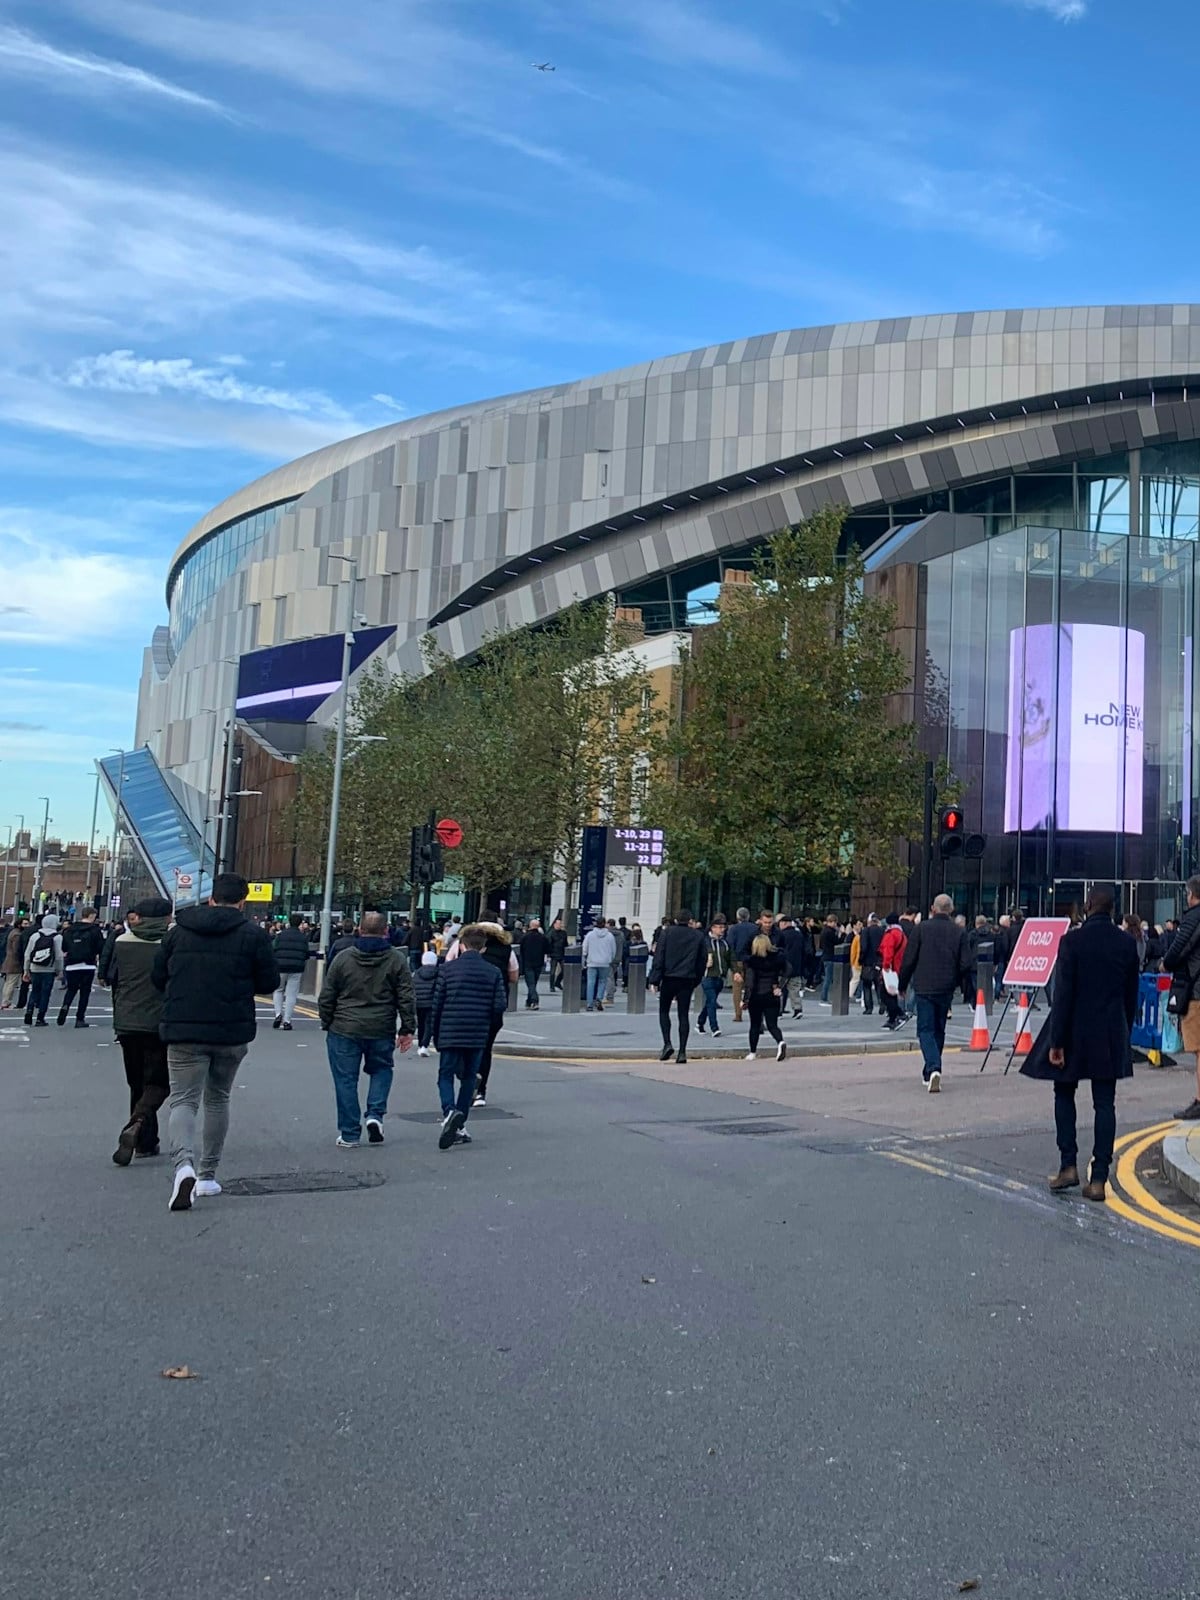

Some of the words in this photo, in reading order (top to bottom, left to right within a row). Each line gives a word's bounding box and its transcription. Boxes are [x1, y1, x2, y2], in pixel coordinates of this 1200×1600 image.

[1109, 702, 1140, 718] NEW
[1084, 713, 1136, 729] HOME
[615, 829, 638, 839] 1-10,
[639, 830, 651, 839] 23
[624, 842, 650, 851] 11-21
[637, 855, 650, 864] 22
[1027, 931, 1053, 946] ROAD
[1014, 956, 1048, 971] CLOSED
